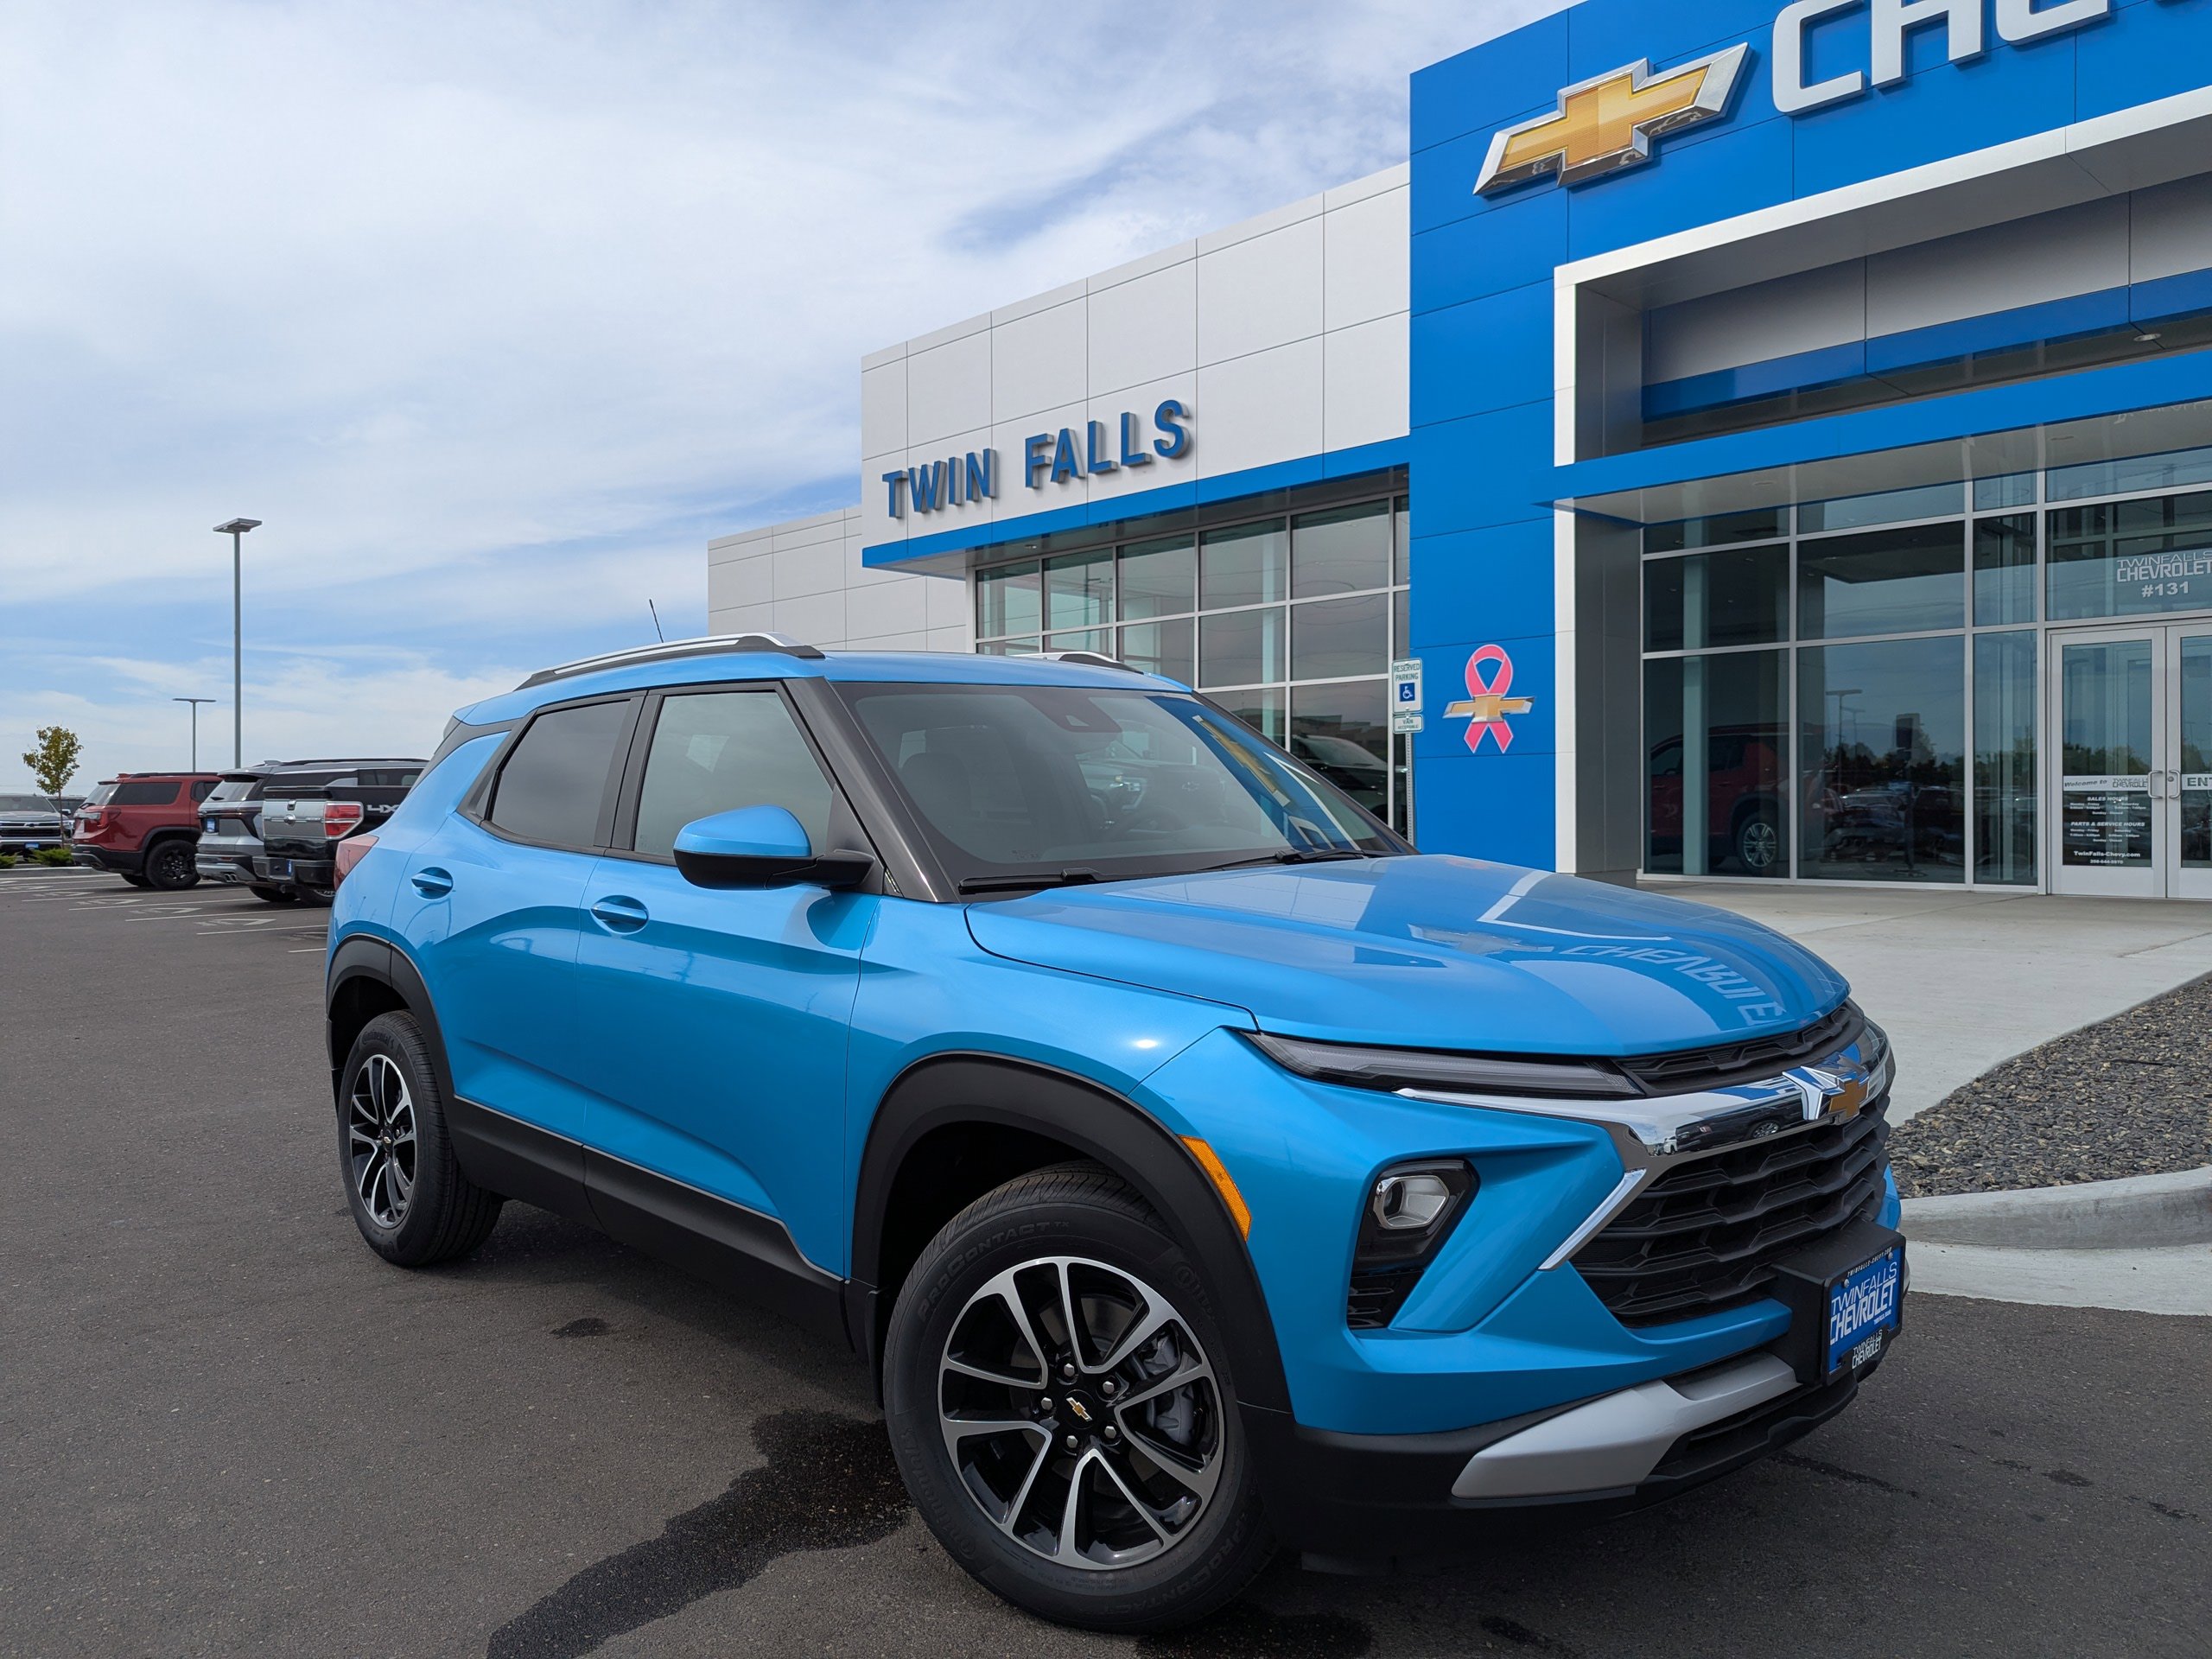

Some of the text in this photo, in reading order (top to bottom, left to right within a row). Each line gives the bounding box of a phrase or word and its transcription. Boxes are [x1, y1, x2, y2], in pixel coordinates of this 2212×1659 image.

[882, 399, 1191, 518] TWIN FALLS
[2141, 581, 2189, 598] #131
[1393, 663, 1420, 673] RESERVED
[1395, 673, 1419, 682] PARKING
[1831, 1262, 1897, 1316] TWINFALLS
[1830, 1277, 1897, 1345] CHEVROLET
[1852, 1338, 1881, 1370] CHEVROLET
[1853, 1329, 1883, 1356] TWINFALLS
